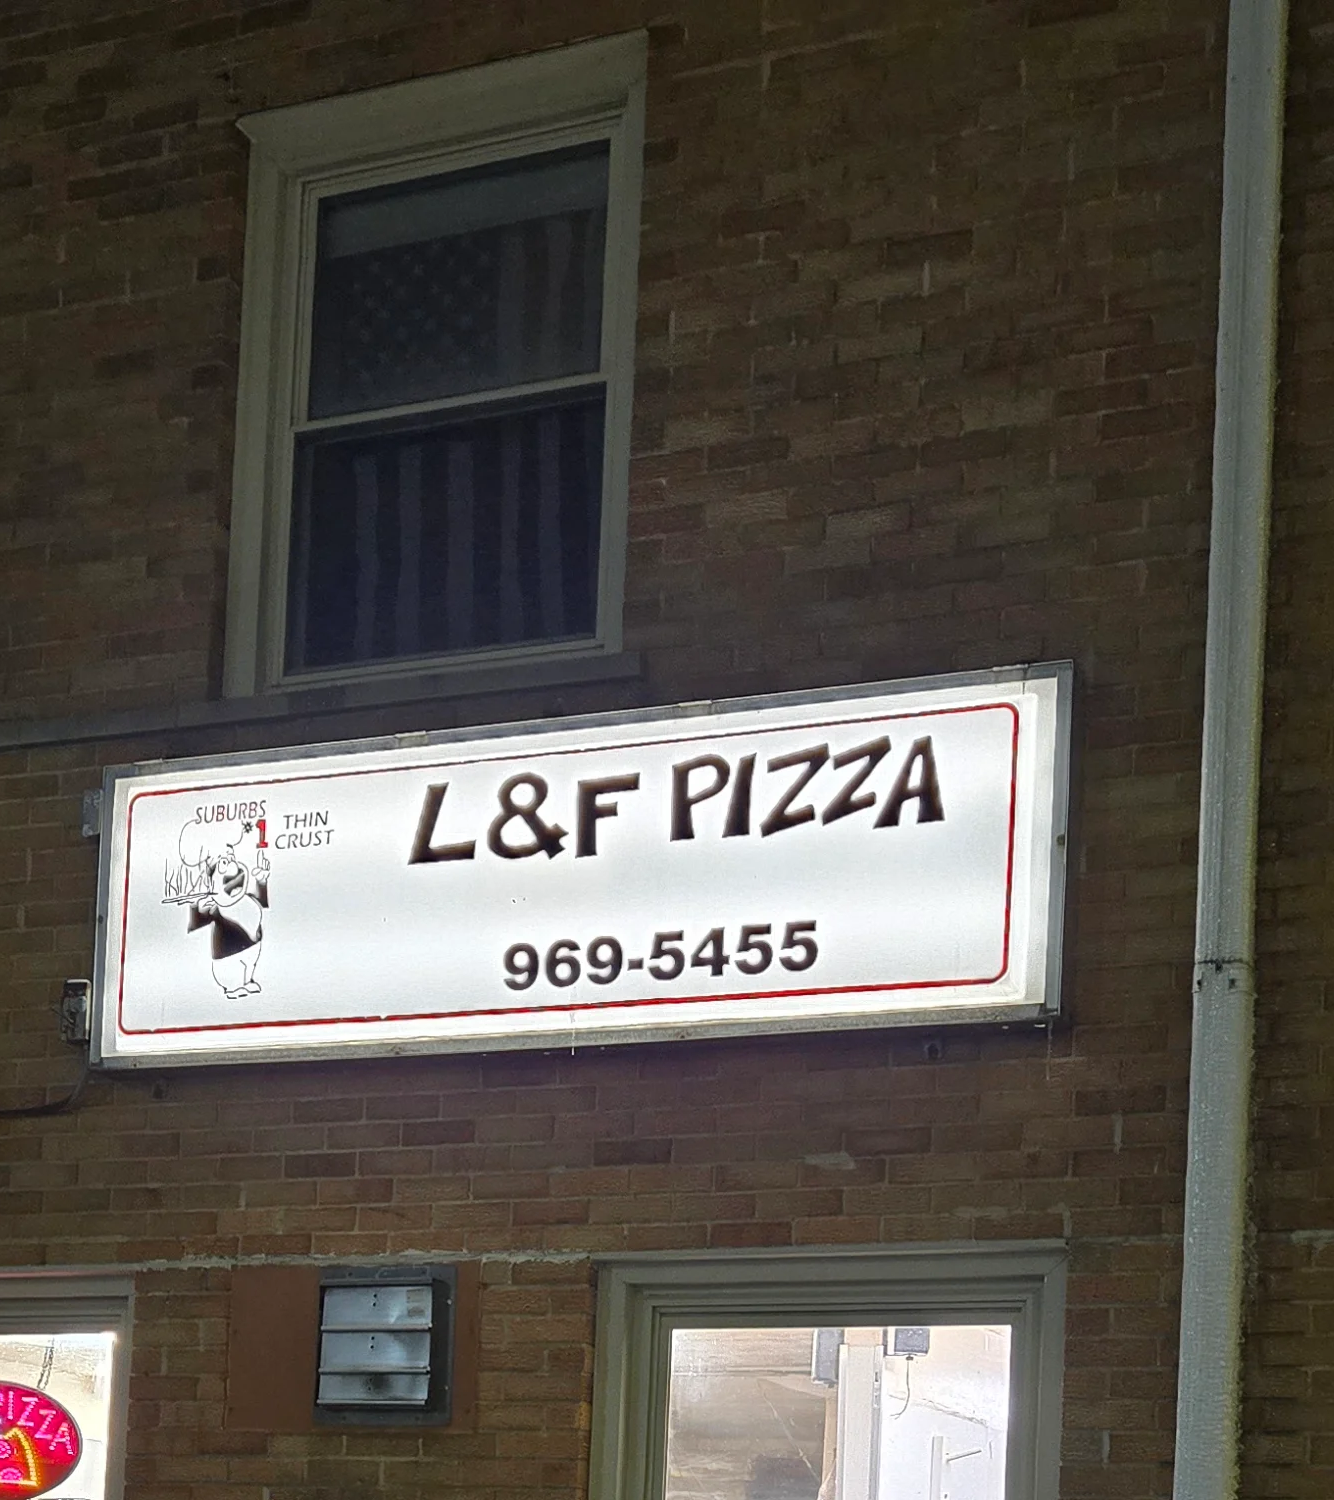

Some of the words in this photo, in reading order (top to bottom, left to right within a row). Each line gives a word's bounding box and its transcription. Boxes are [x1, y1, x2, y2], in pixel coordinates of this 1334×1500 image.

[195, 800, 267, 825] SUBURBS
[407, 772, 640, 866] L&F
[669, 734, 945, 841] PIZZA
[283, 810, 329, 830] THIN
[274, 829, 335, 850] CRUST
[502, 921, 819, 991] 969-5455
